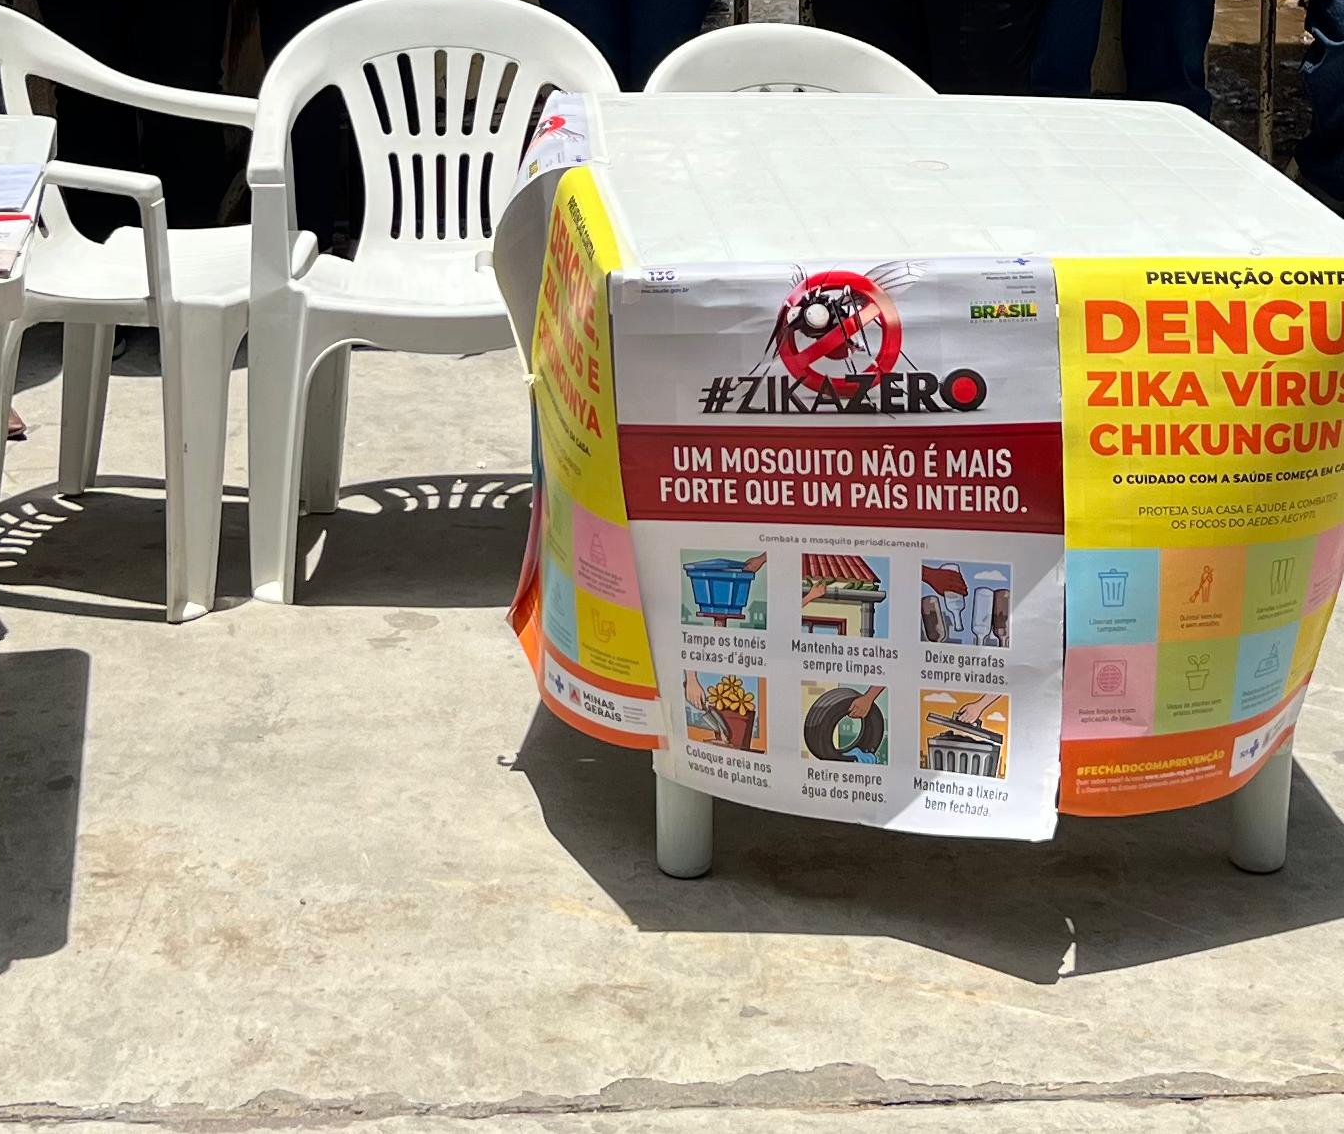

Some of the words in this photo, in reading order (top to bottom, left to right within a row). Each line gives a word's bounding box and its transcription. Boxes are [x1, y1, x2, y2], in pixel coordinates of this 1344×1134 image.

[1146, 267, 1274, 289] PREVENÇÃO
[970, 302, 1038, 320] BRASIL
[698, 368, 987, 415] #ZIKAZERO
[1087, 371, 1209, 407] ZIKA
[673, 446, 712, 473] UM
[721, 448, 853, 477] MOSQUITO
[862, 444, 915, 478] NÃO
[924, 443, 937, 478] É
[946, 449, 1012, 479] MAIS
[1113, 474, 1122, 485] O
[1126, 474, 1186, 485] CUIDADO
[1189, 474, 1216, 485] COM
[1221, 474, 1230, 484] A
[1233, 468, 1273, 483] SAÚDE
[1276, 467, 1318, 483] COMEÇA
[1321, 466, 1334, 477] EM
[660, 476, 737, 504] FORTE
[745, 478, 795, 506] QUE
[803, 481, 842, 508] UM
[850, 477, 908, 510] PAÍS
[917, 484, 1028, 514] INTEIRO.
[1138, 505, 1188, 517] PROTEJA
[1192, 504, 1213, 515] SUA
[1215, 503, 1244, 515] CASA
[1246, 503, 1253, 514] E
[1255, 501, 1287, 514] AJUDE
[1288, 500, 1296, 511] A
[1297, 492, 1337, 510] COMBATER
[1171, 519, 1186, 529] OS
[1189, 518, 1226, 529] FOCOS
[1228, 517, 1244, 527] DO
[1246, 515, 1280, 527] AEDES
[759, 534, 798, 545] Combata
[809, 536, 852, 548] mosquito
[682, 631, 716, 647] Tampe
[719, 638, 729, 647] os
[733, 634, 766, 650] tonéis
[791, 640, 844, 655] Mantenha
[847, 647, 859, 657] as
[862, 645, 898, 659] calhas
[681, 651, 687, 660] e
[689, 650, 767, 667] caixas-d'água.
[803, 659, 846, 674] sempre
[850, 660, 886, 676] limpas.
[925, 650, 955, 665] Deixe
[957, 655, 1005, 670] garrafas
[920, 669, 961, 683] sempre
[964, 671, 1009, 686] viradas.
[583, 691, 615, 711] MINAS
[584, 703, 622, 722] GERAIS
[686, 745, 723, 767] Coloque
[726, 756, 751, 773] areia
[754, 762, 772, 774] nos
[688, 761, 715, 777] vasos
[718, 766, 729, 779] de
[732, 770, 772, 789] plantas.
[807, 767, 838, 782] Retire
[842, 773, 882, 788] sempre
[802, 785, 828, 802] água
[830, 788, 848, 800] dos
[852, 790, 887, 805] pneus.
[914, 777, 964, 797] Mantenha
[967, 787, 973, 797] a
[975, 783, 1009, 802] lixeira
[925, 797, 946, 812] bem
[949, 799, 992, 818] fechada.
